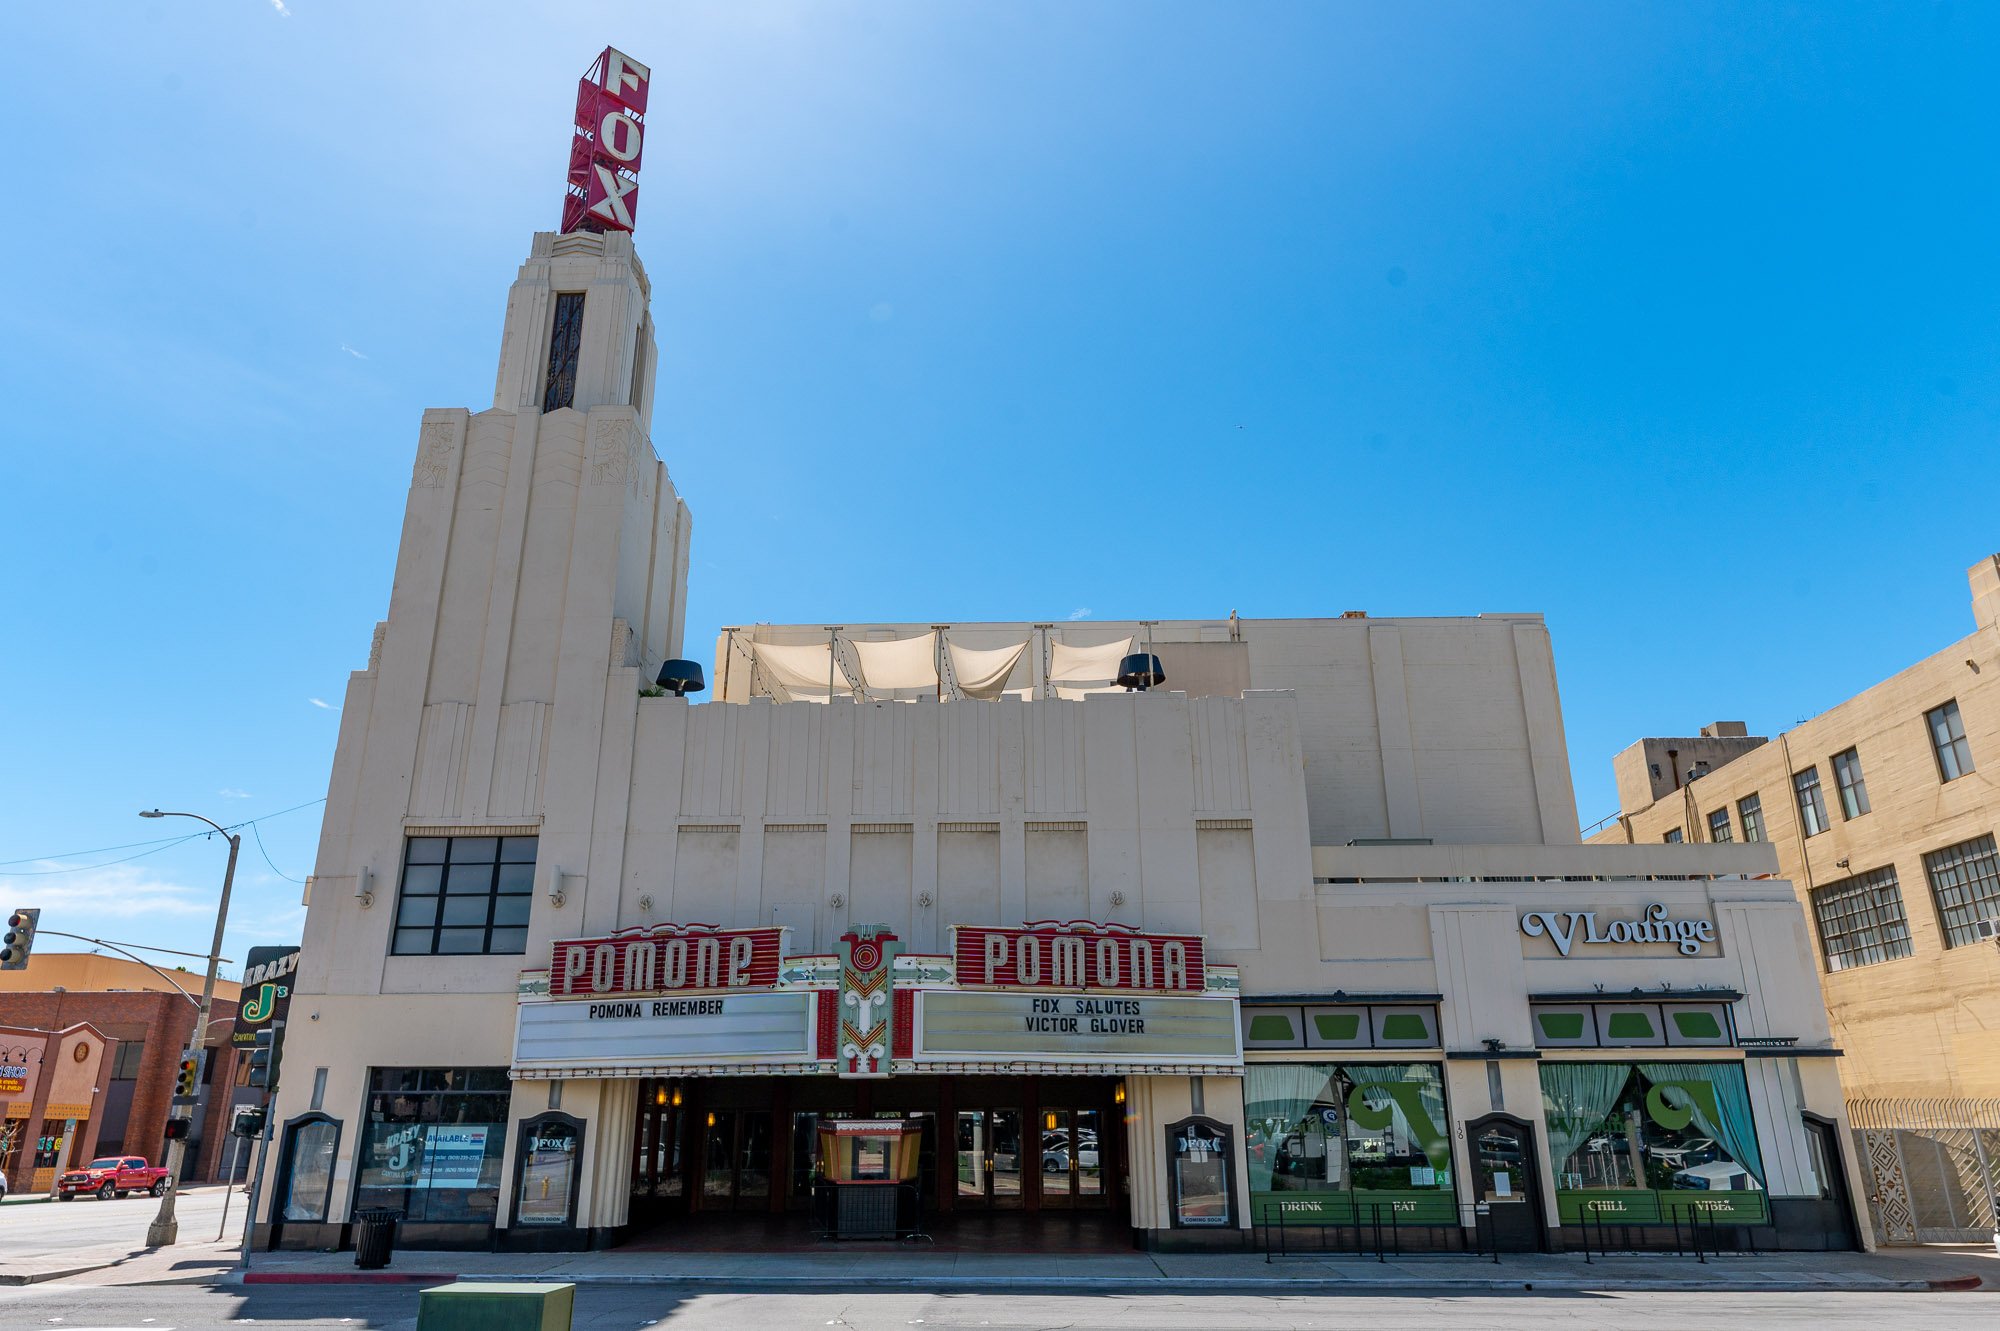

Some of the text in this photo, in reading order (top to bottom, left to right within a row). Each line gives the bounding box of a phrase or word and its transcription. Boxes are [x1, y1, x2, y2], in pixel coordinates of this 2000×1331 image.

[590, 46, 651, 231] FOX
[984, 933, 1187, 989] POMONA
[242, 952, 300, 989] KRAZY
[589, 1000, 724, 1019] POMONA REMEMBER
[1032, 998, 1141, 1015] FOX SALUTES
[1025, 1016, 1145, 1034] VICTOR GLOVER
[3, 1065, 28, 1079] SHOP
[385, 1124, 421, 1150] KRAZY
[427, 1134, 469, 1143] AVAILABLE
[539, 1138, 563, 1148] FOX
[1188, 1139, 1212, 1148] FOX
[1281, 1201, 1323, 1212] DRINK
[1392, 1201, 1418, 1212] EAT
[1588, 1200, 1628, 1212] CHILL
